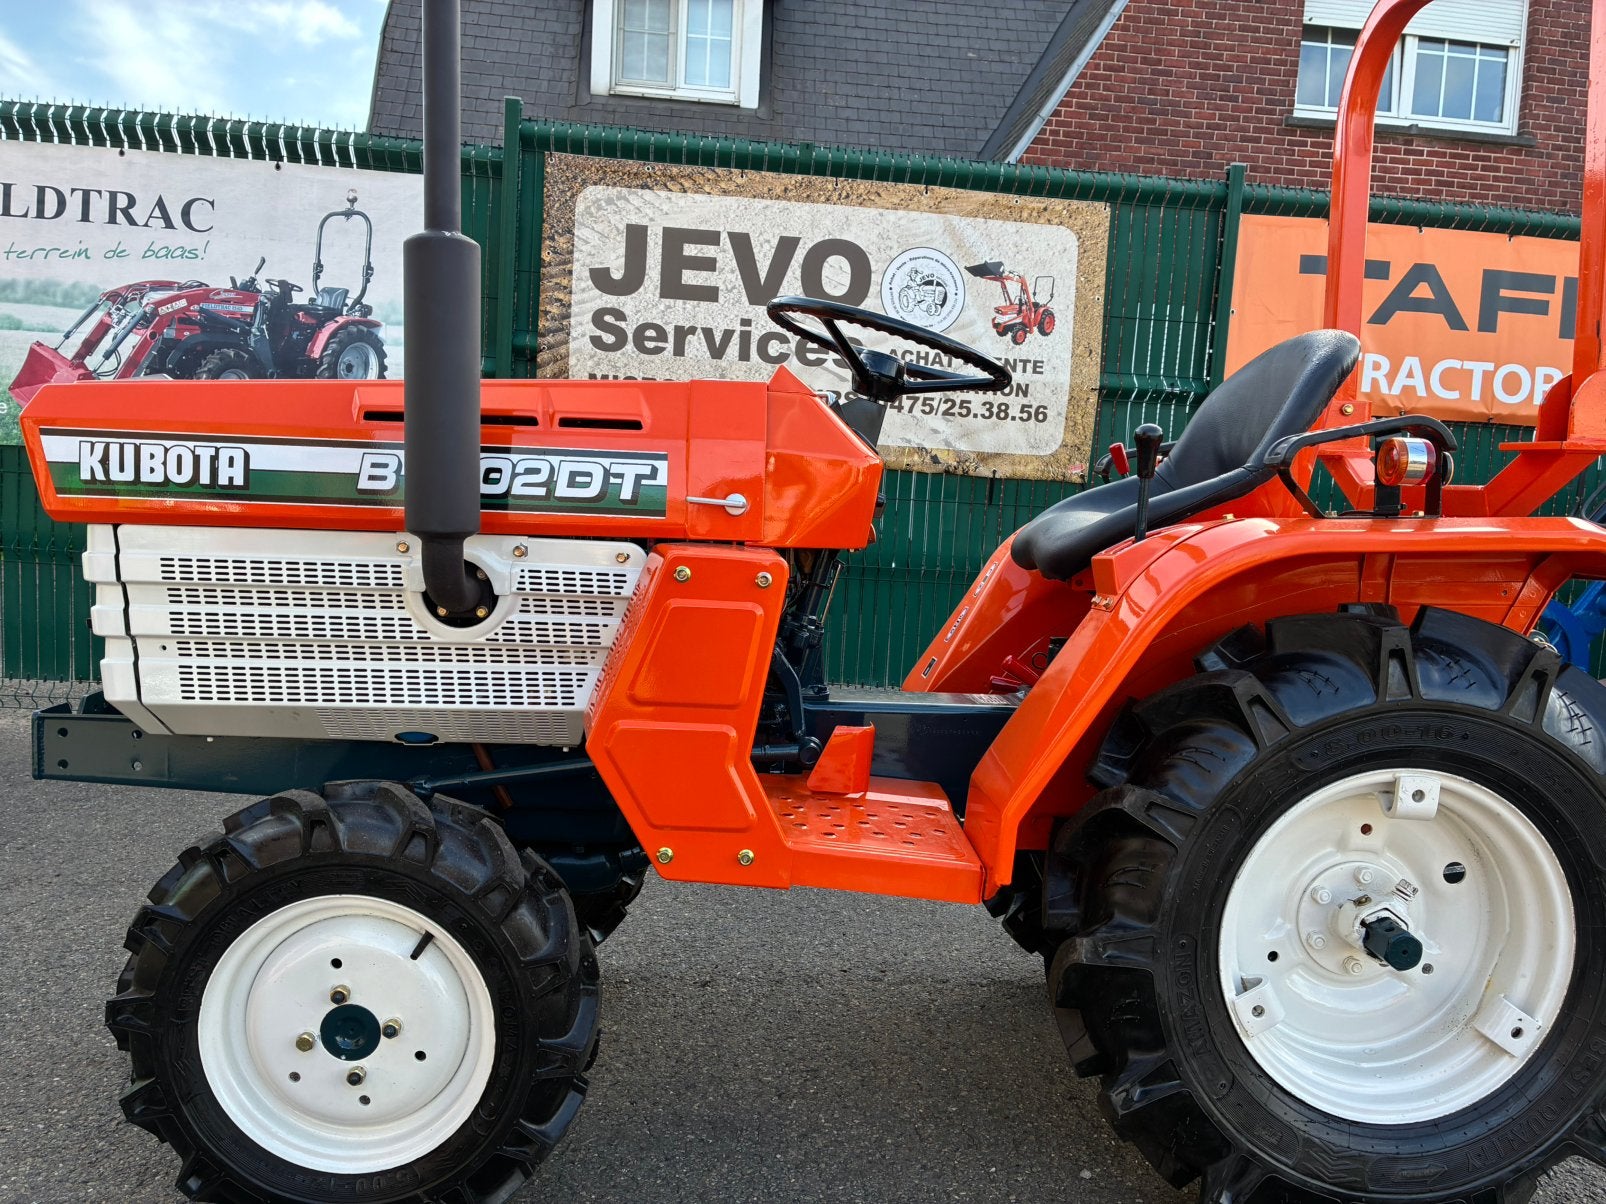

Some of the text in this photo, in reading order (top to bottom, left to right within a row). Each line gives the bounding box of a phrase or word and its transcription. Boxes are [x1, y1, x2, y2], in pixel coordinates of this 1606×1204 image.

[0, 182, 215, 233] LDTRAC
[3, 240, 210, 261] terrein de baas!
[589, 223, 873, 308] JEVO
[887, 395, 1049, 424] 475/25.38.56
[79, 440, 251, 491] KUBOTA
